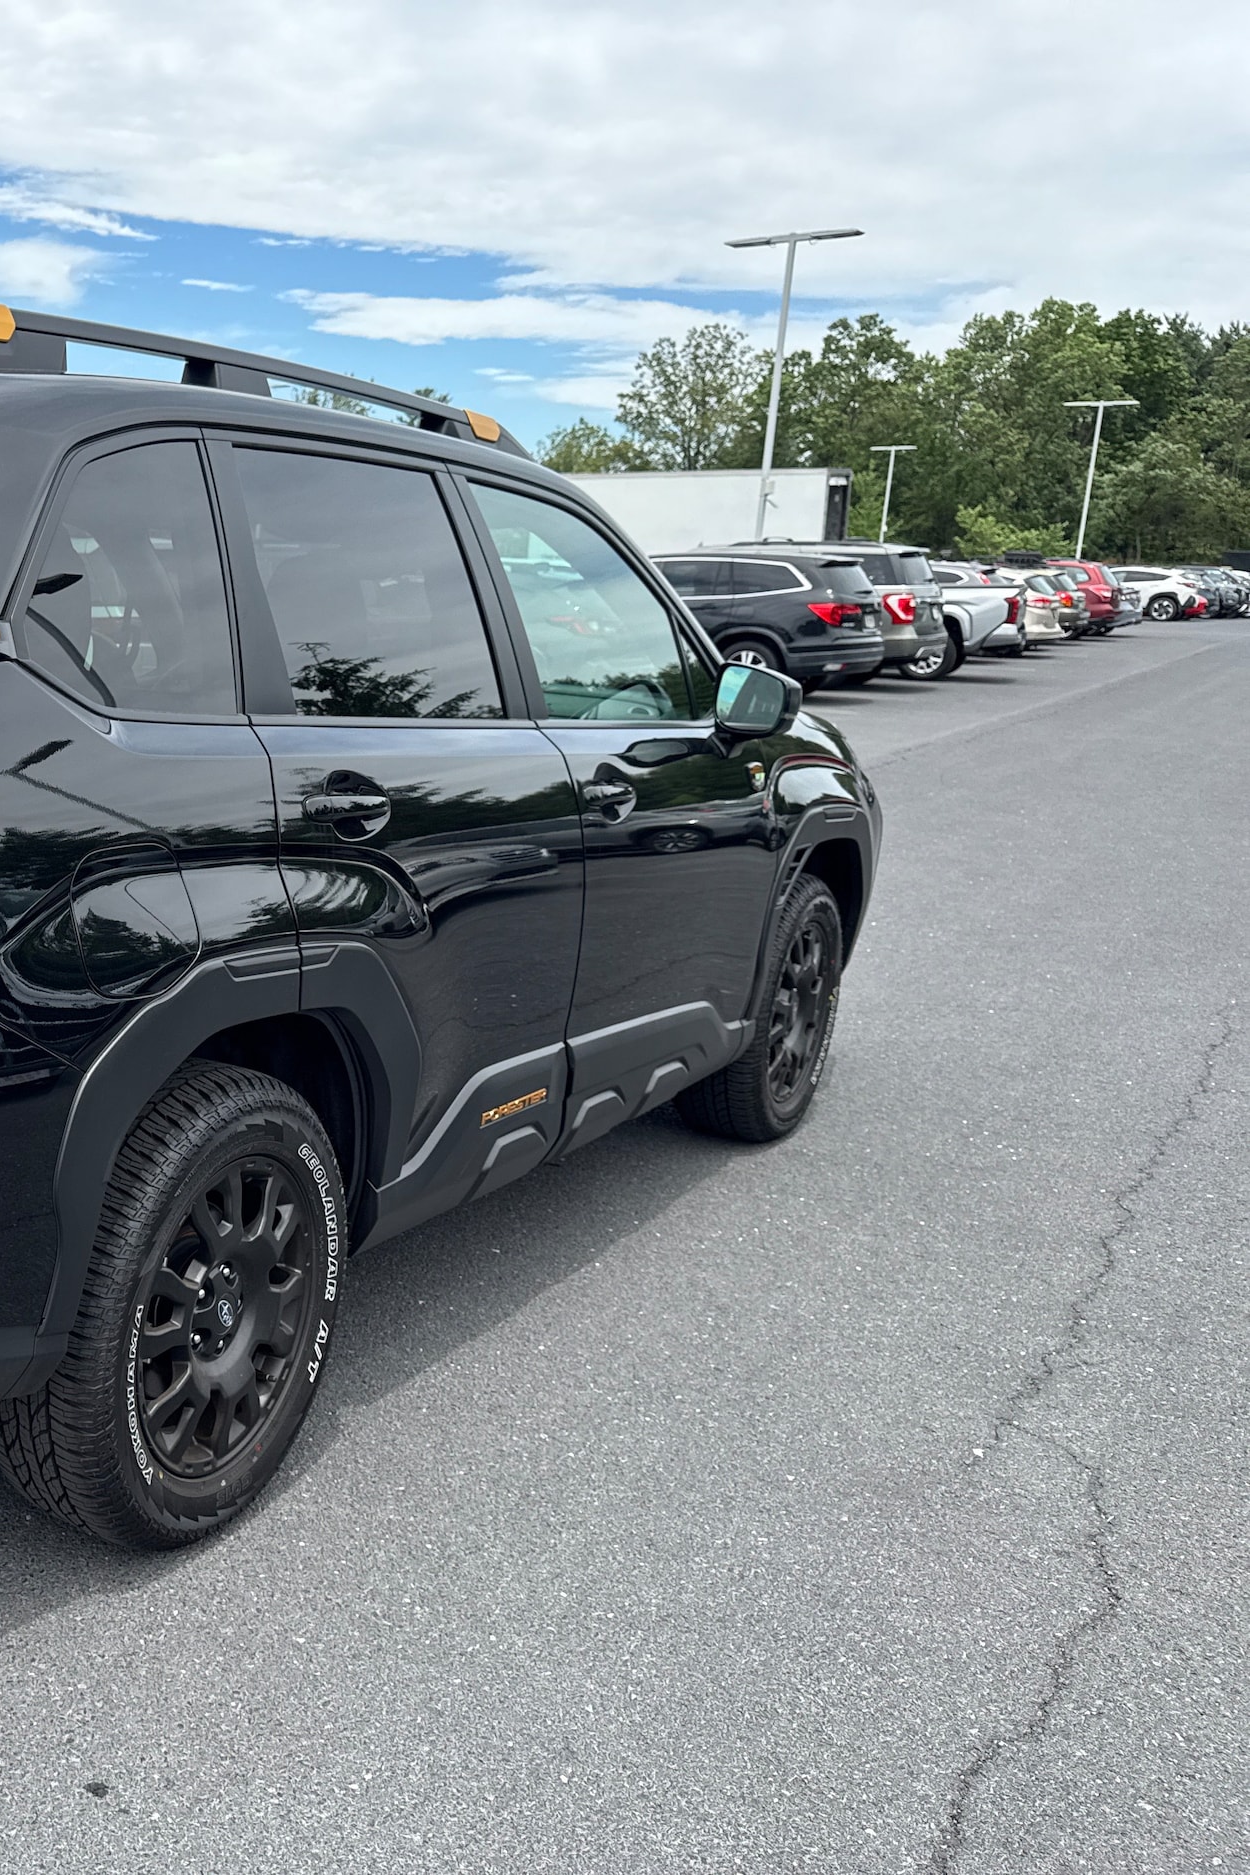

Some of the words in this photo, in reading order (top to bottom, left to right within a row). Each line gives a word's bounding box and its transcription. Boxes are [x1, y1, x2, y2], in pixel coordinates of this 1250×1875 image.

[480, 1088, 547, 1127] FORESTER
[297, 1143, 339, 1302] GEOLANDAR
[126, 1305, 154, 1486] YOKOHAMA
[307, 1318, 330, 1384] A/T
